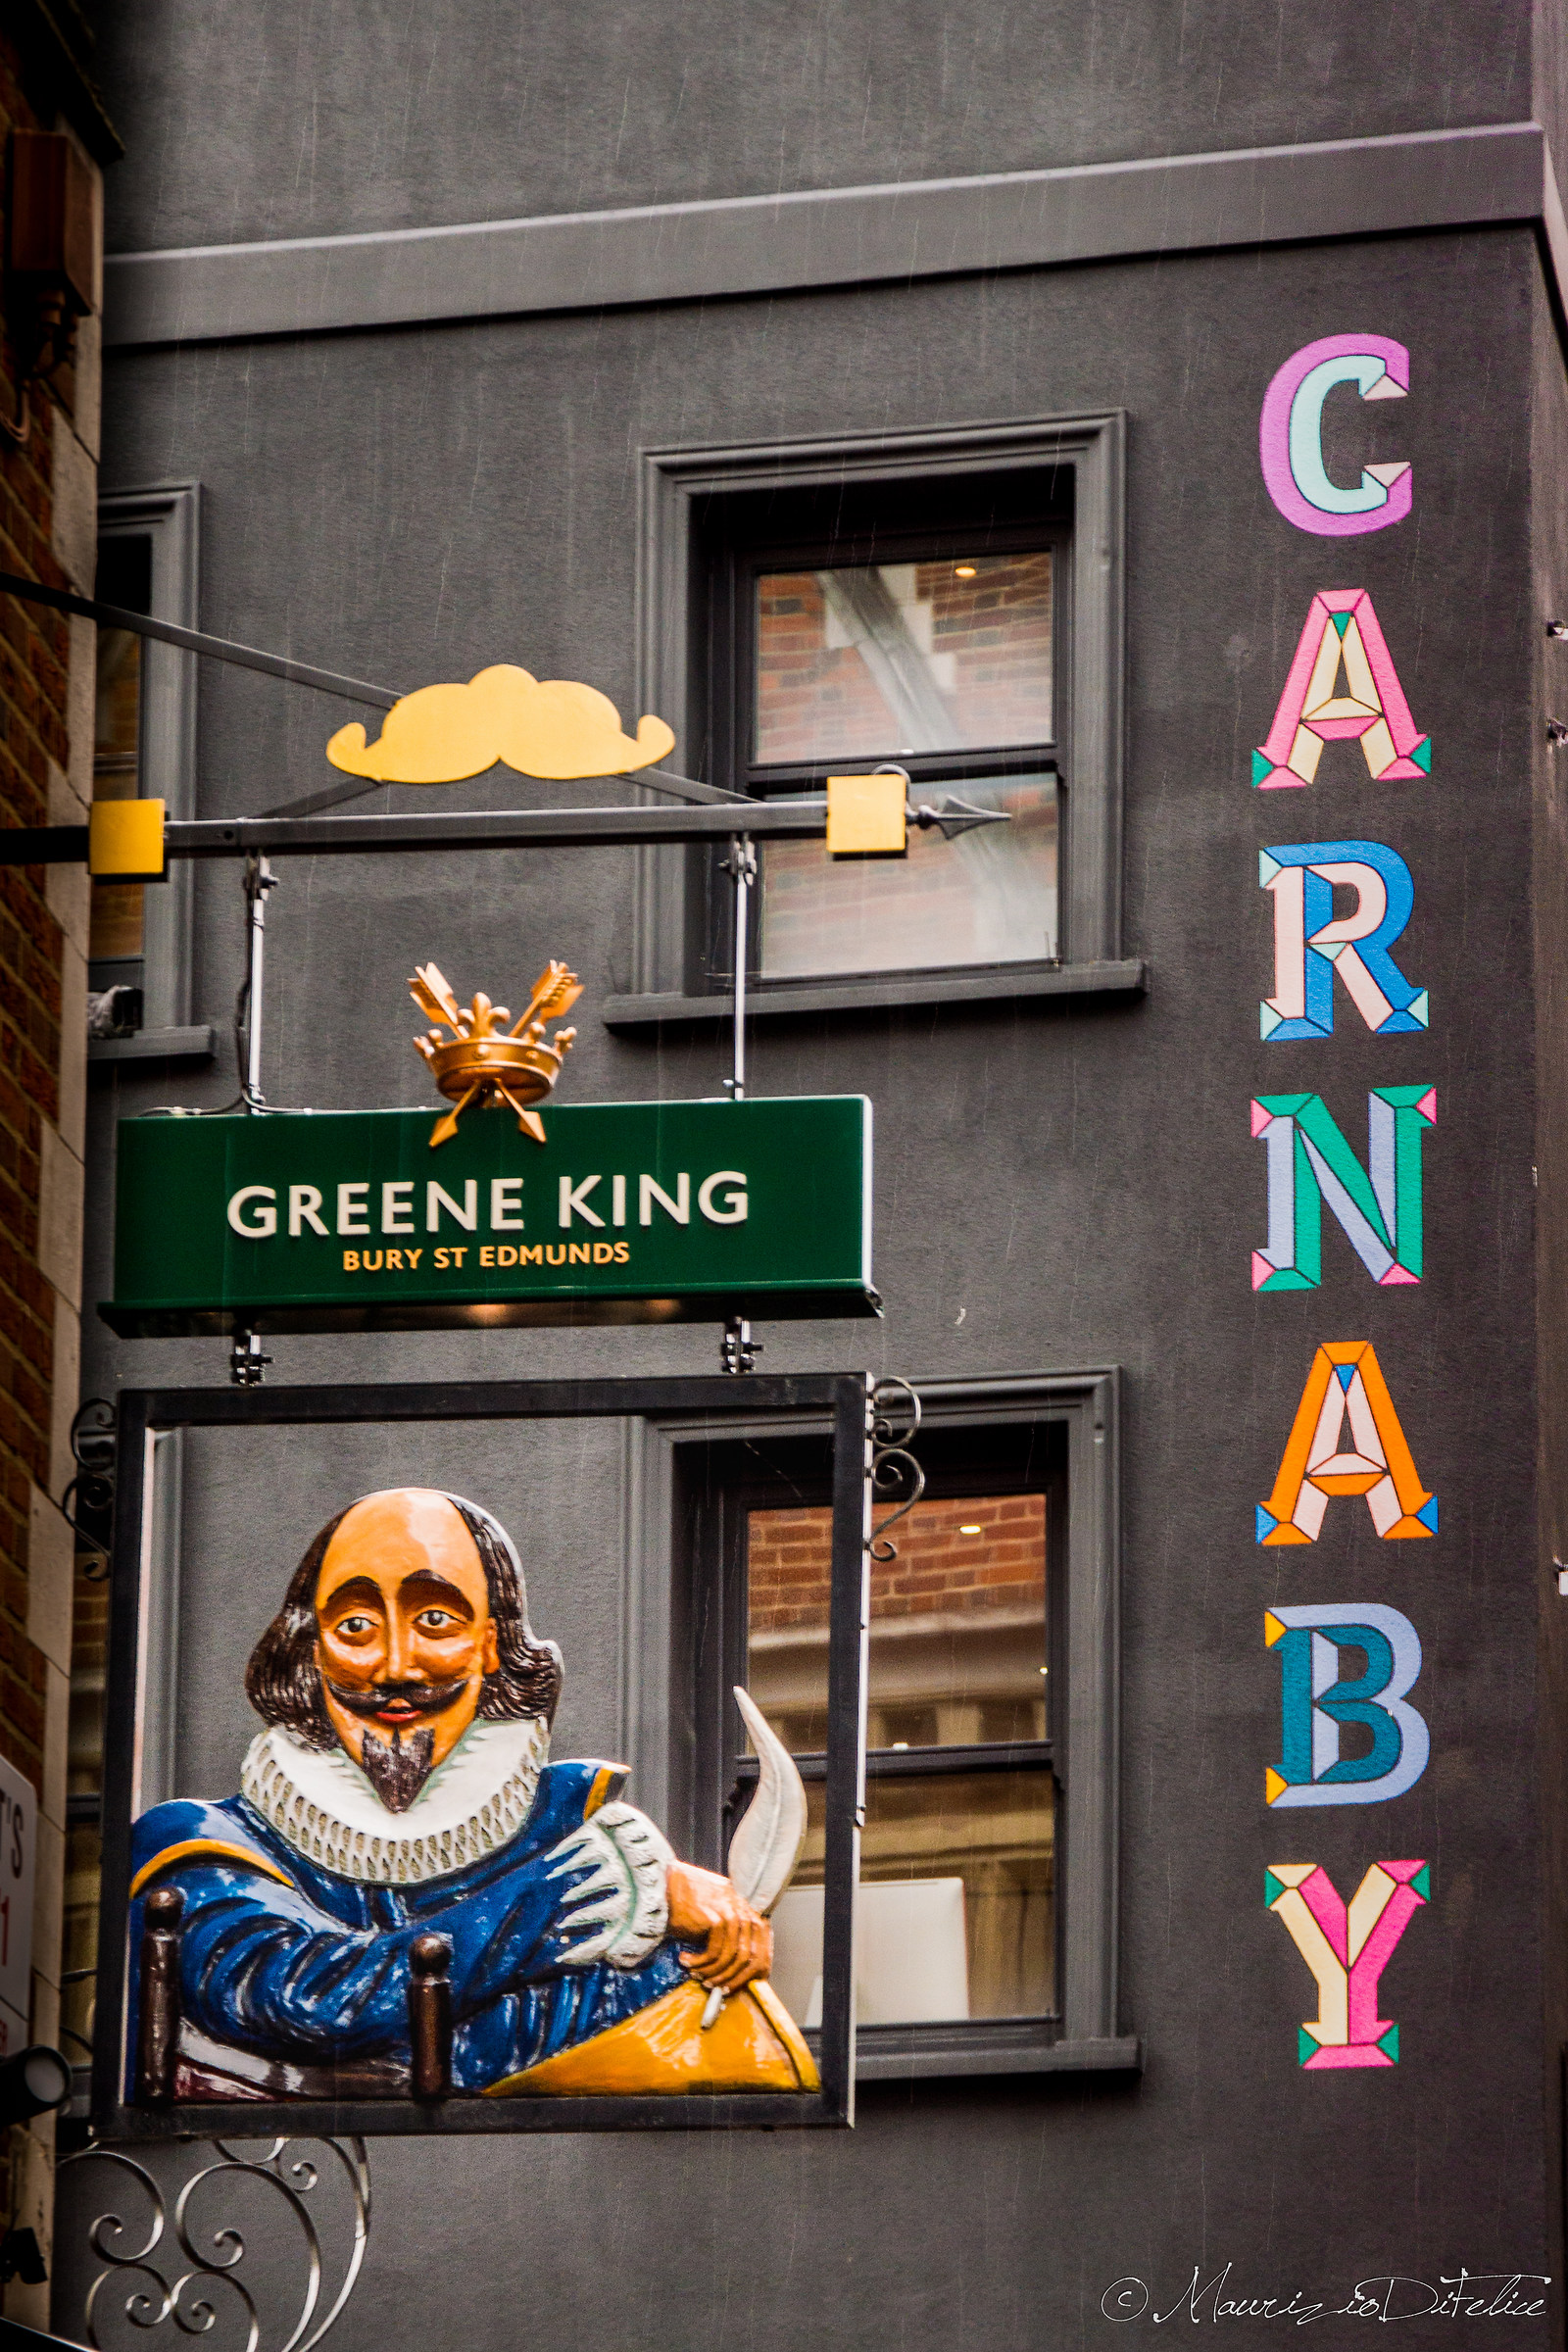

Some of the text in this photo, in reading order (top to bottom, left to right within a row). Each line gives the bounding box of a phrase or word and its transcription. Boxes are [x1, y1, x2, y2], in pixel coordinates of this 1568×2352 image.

[226, 1170, 749, 1238] GREENE KING
[1250, 332, 1438, 2071] CARNABY
[342, 1241, 630, 1271] BURY ST EDMUNDS
